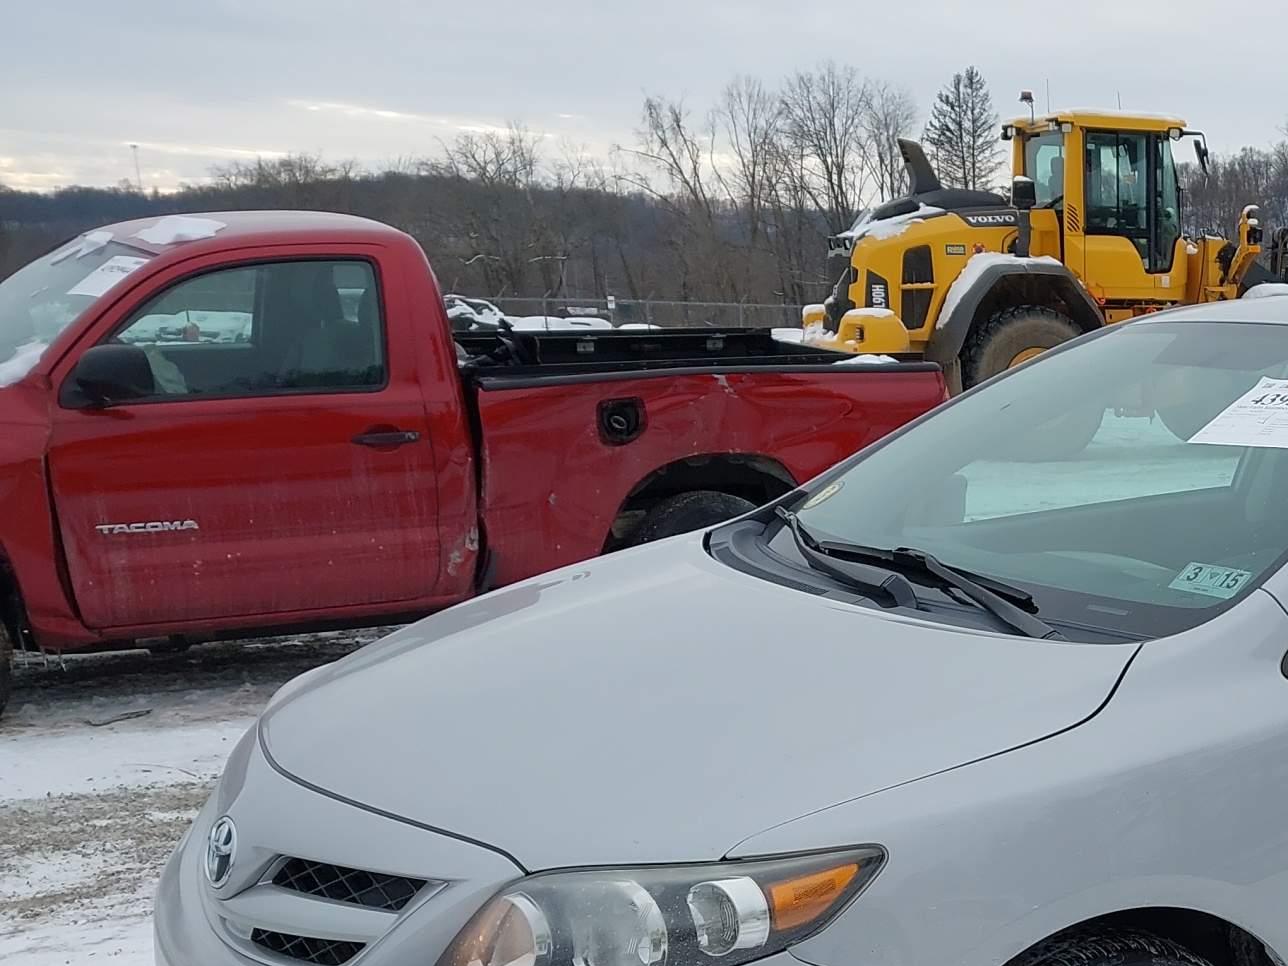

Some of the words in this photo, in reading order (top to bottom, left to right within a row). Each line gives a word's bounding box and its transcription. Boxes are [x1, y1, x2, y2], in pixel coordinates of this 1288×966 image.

[966, 214, 1015, 223] VOLVO
[95, 519, 199, 534] TACOMA
[1186, 566, 1203, 581] 3
[1219, 571, 1244, 589] 15
